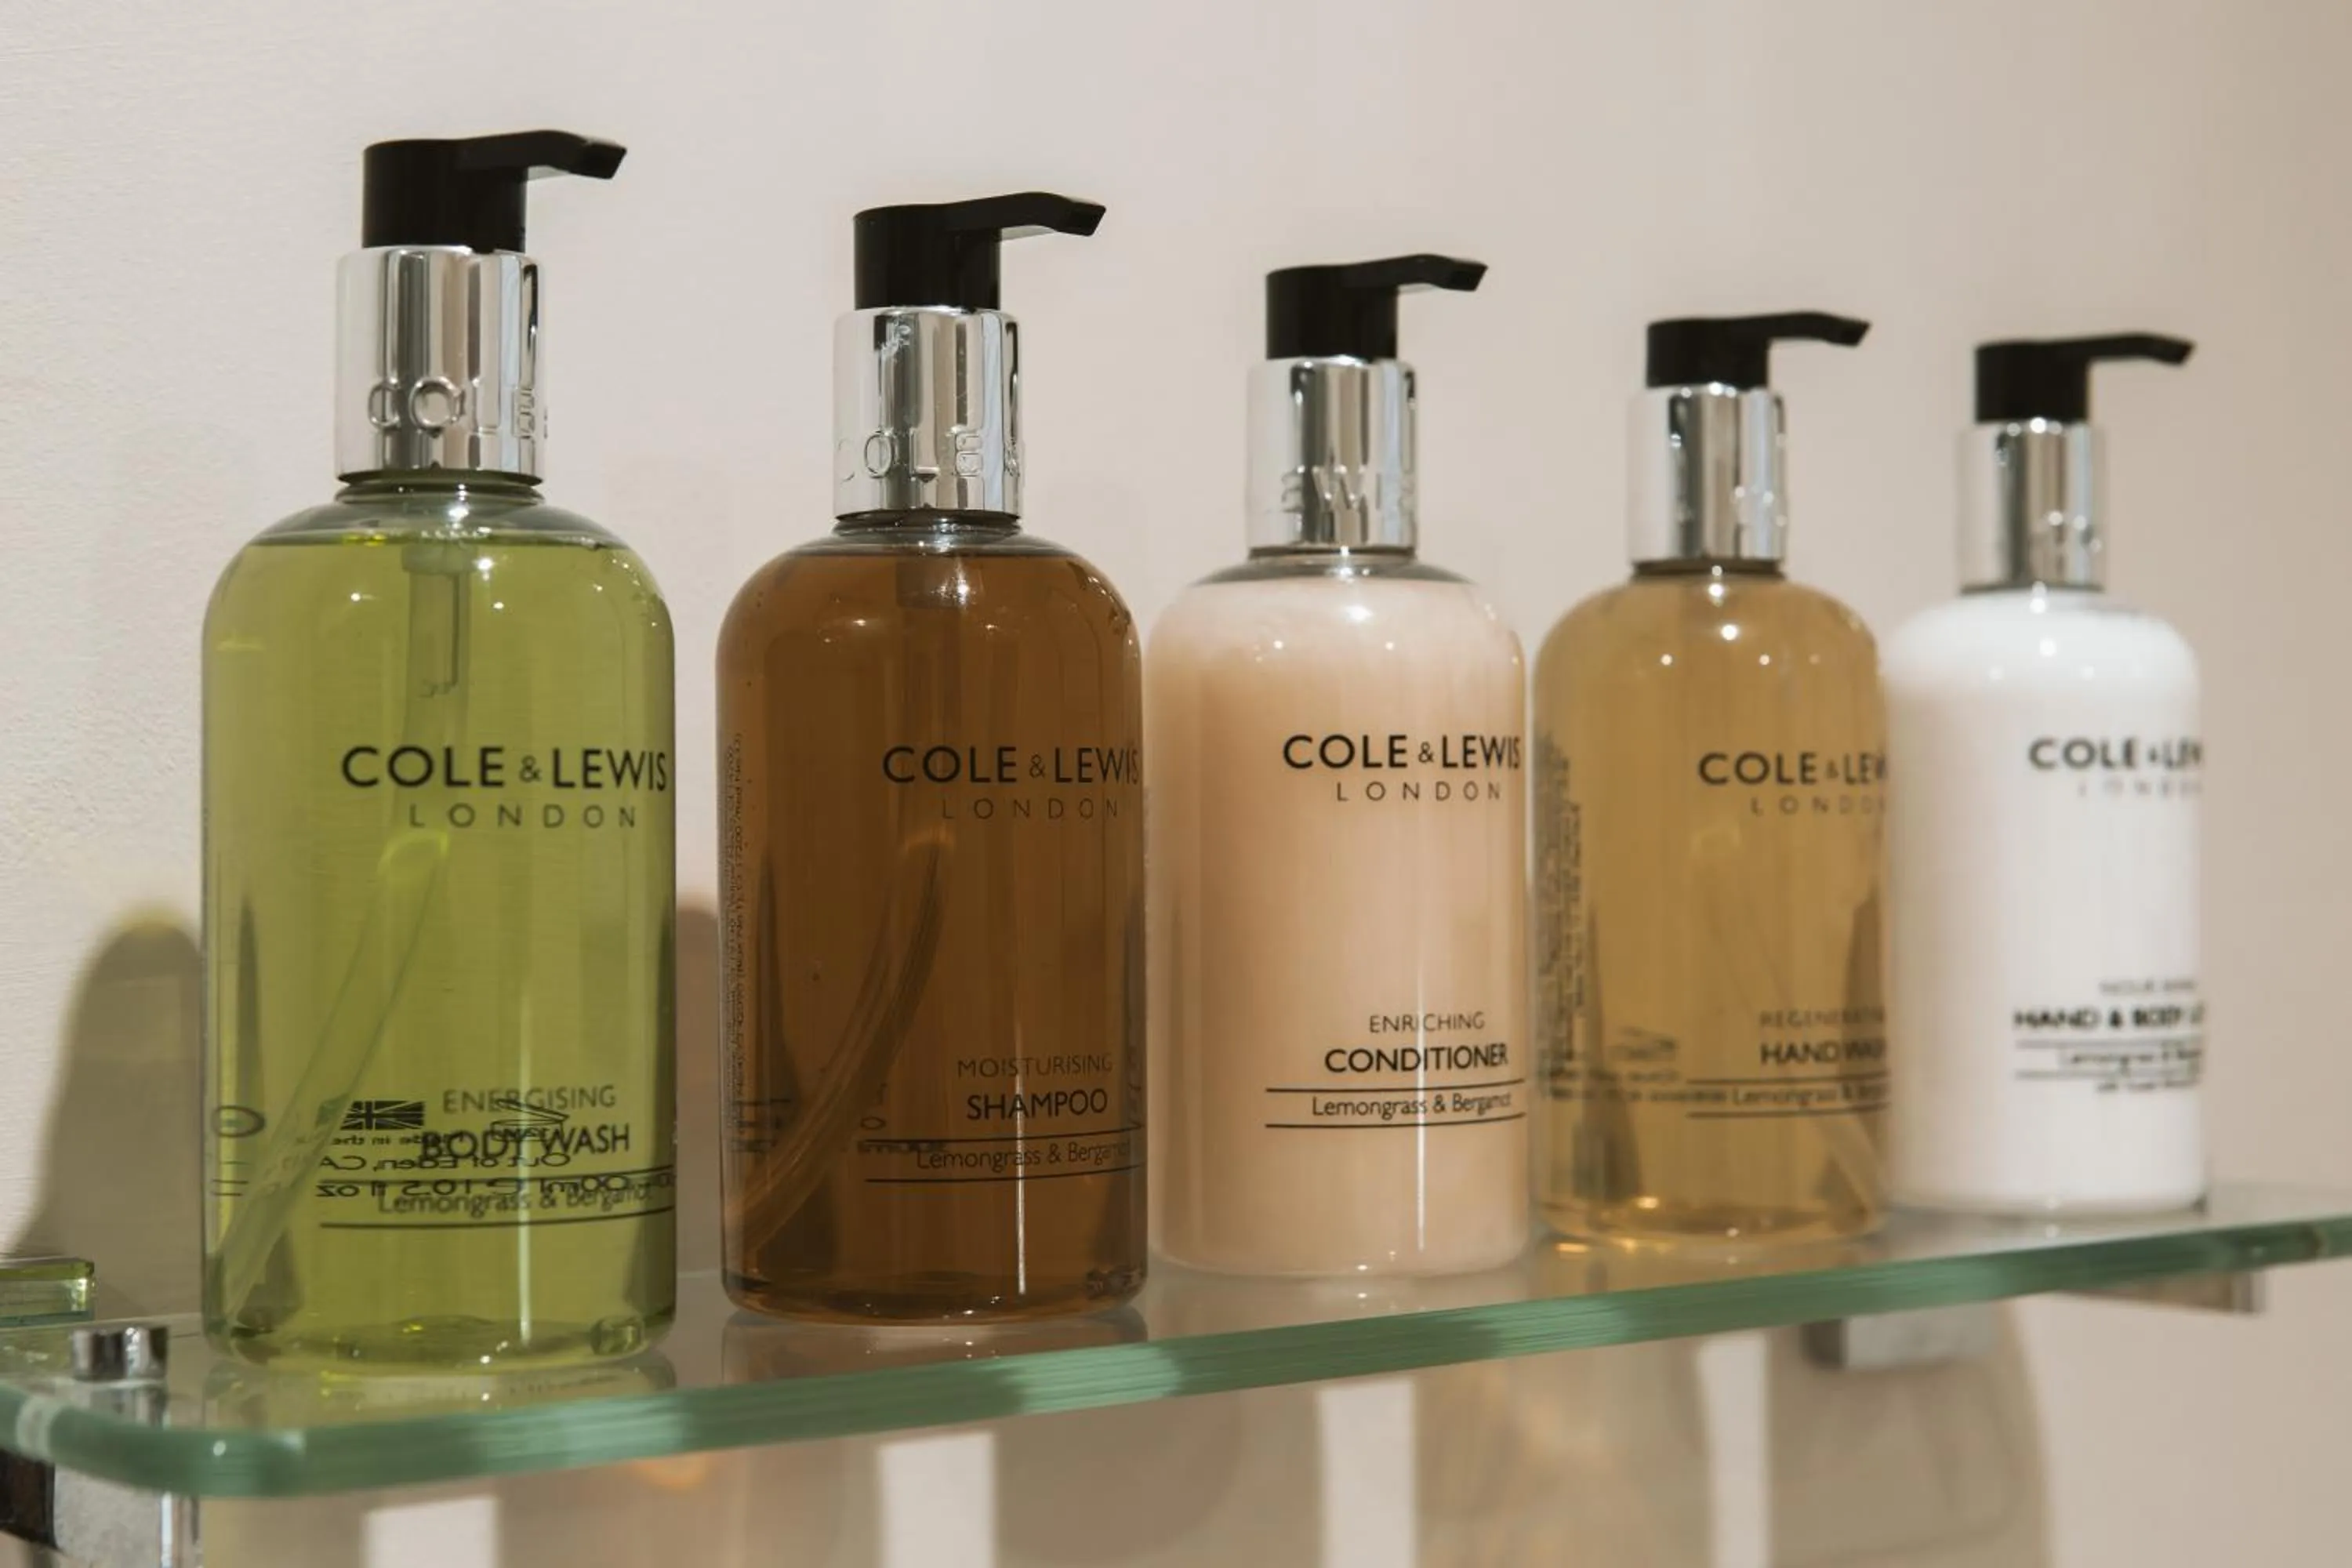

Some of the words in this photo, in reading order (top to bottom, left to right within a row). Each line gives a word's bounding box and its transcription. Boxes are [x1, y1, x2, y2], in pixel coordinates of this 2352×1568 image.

[883, 746, 1017, 783] COLE
[1029, 753, 1046, 779] &
[1054, 746, 1139, 786] LEWIS
[1283, 735, 1408, 769] COLE
[1417, 742, 1435, 764] &
[1442, 735, 1521, 769] LEWIS
[341, 746, 506, 787] COLE
[520, 755, 541, 783] &
[552, 747, 667, 791] LEWIS
[1698, 751, 1818, 786] COLE
[1337, 781, 1501, 801] LONDON
[408, 803, 637, 829] LONDON
[942, 798, 1118, 819] LONDON
[1370, 1011, 1485, 1033] ENRICHING
[957, 1053, 1112, 1079] MOISTURISING
[1324, 1043, 1508, 1073] CONDITIONER
[1760, 1041, 1841, 1065] HAND
[442, 1085, 616, 1114] ENERGISING
[967, 1088, 1108, 1121] SHAMPOO
[1312, 1096, 1428, 1120] Lemongrass
[1432, 1094, 1446, 1114] &
[423, 1127, 533, 1160] BODY
[541, 1124, 630, 1155] WASH
[916, 1148, 1040, 1173] Lemongrass
[1049, 1143, 1062, 1165] &
[378, 1181, 531, 1218] Lemongrass
